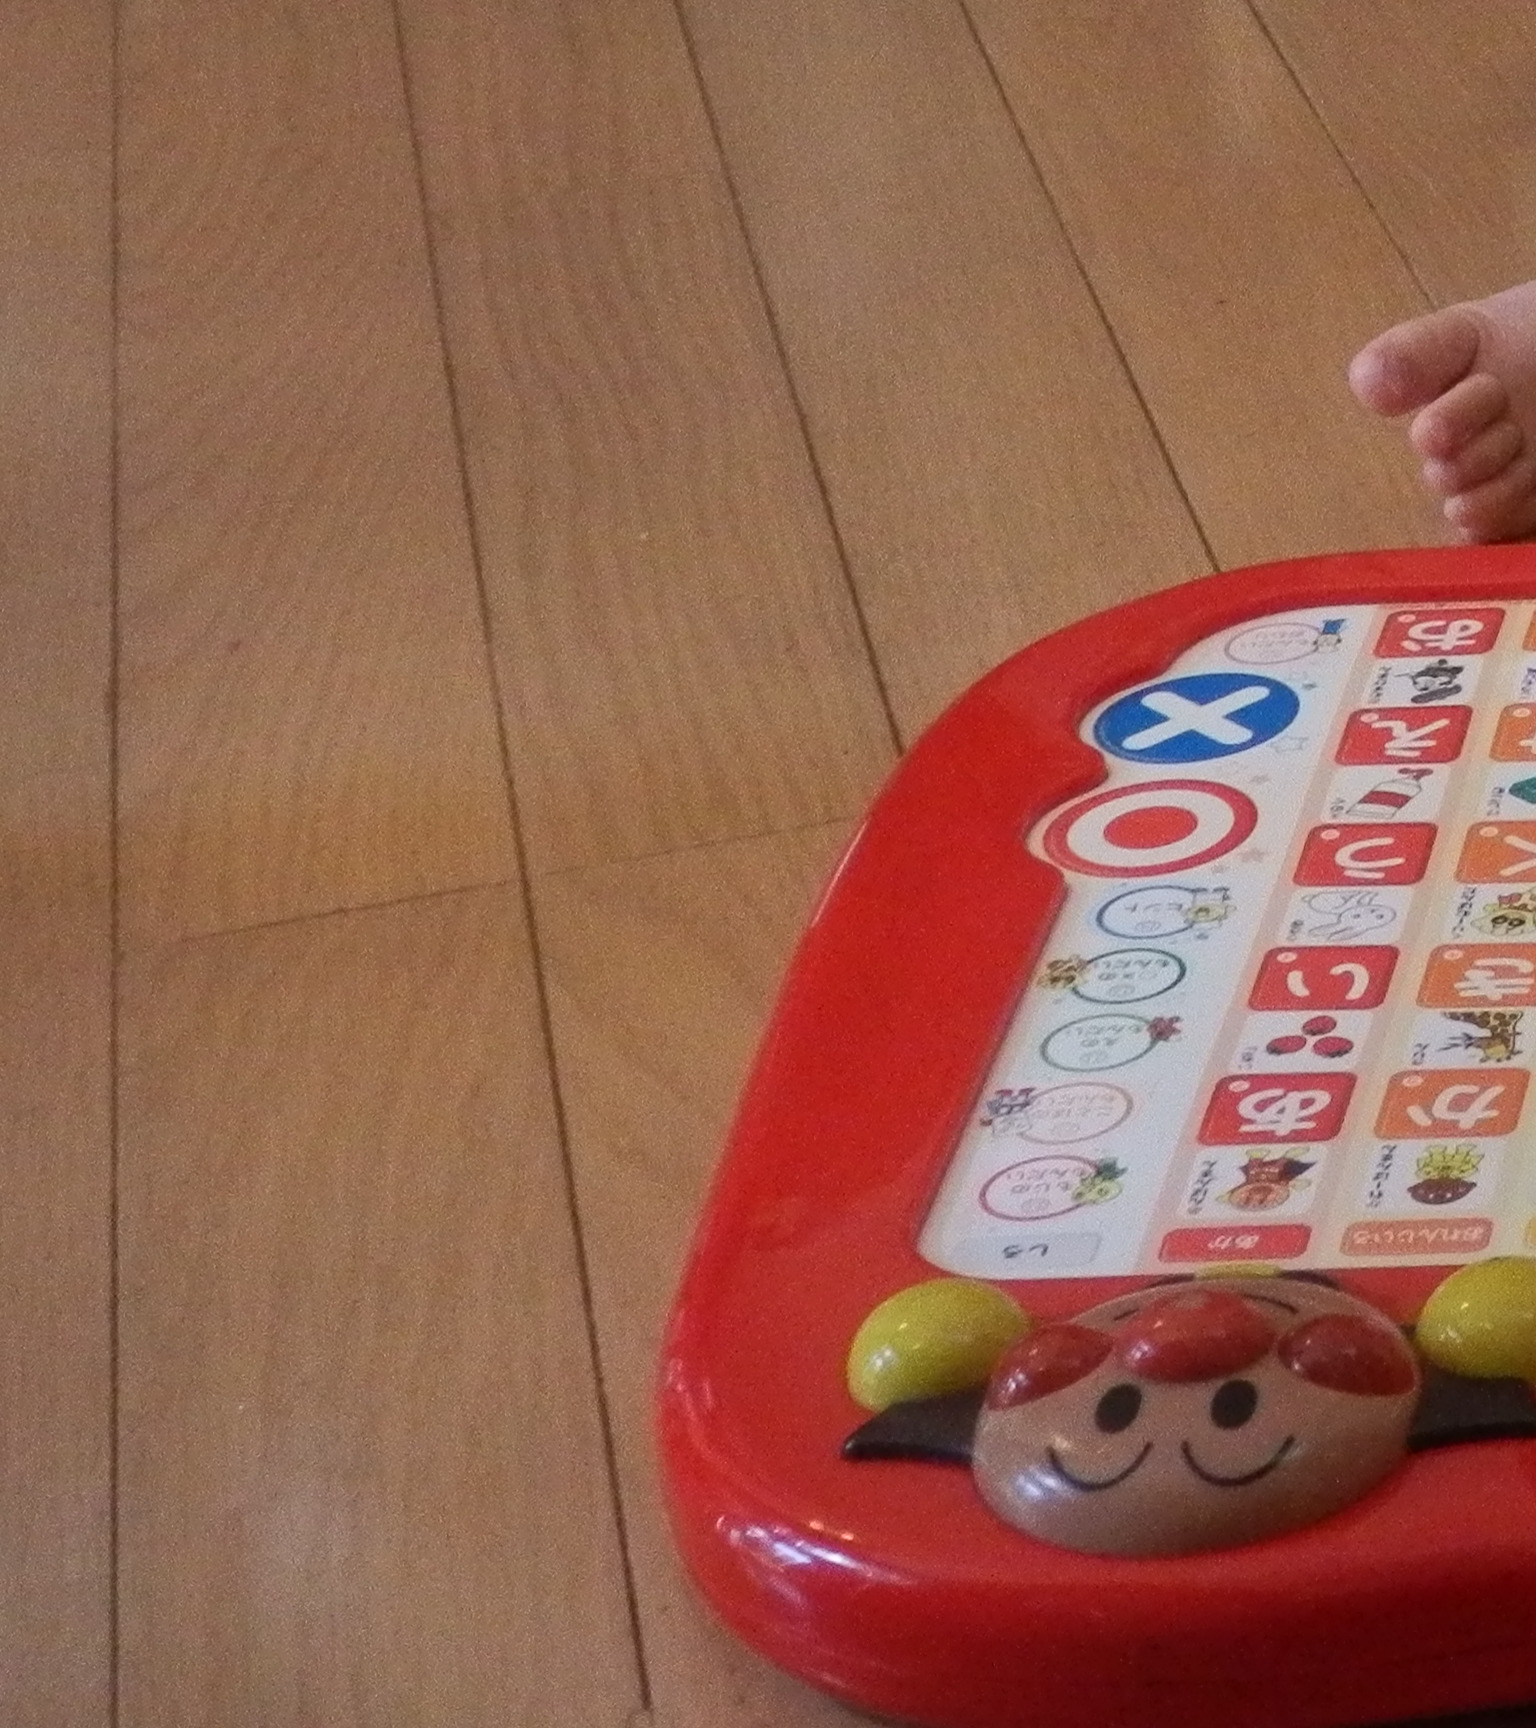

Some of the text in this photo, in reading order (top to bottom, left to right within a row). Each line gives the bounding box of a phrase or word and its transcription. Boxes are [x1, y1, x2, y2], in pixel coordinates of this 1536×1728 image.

[1401, 619, 1482, 651] お
[1378, 719, 1449, 756] え
[1334, 837, 1404, 878] う
[1287, 963, 1368, 999] い
[1454, 957, 1533, 1000] き
[1237, 1088, 1330, 1135] あ
[1407, 1084, 1503, 1129] か
[1002, 1242, 1049, 1258] しろ
[1209, 1232, 1258, 1250] あか
[1353, 1224, 1483, 1246] おれんじいろ
